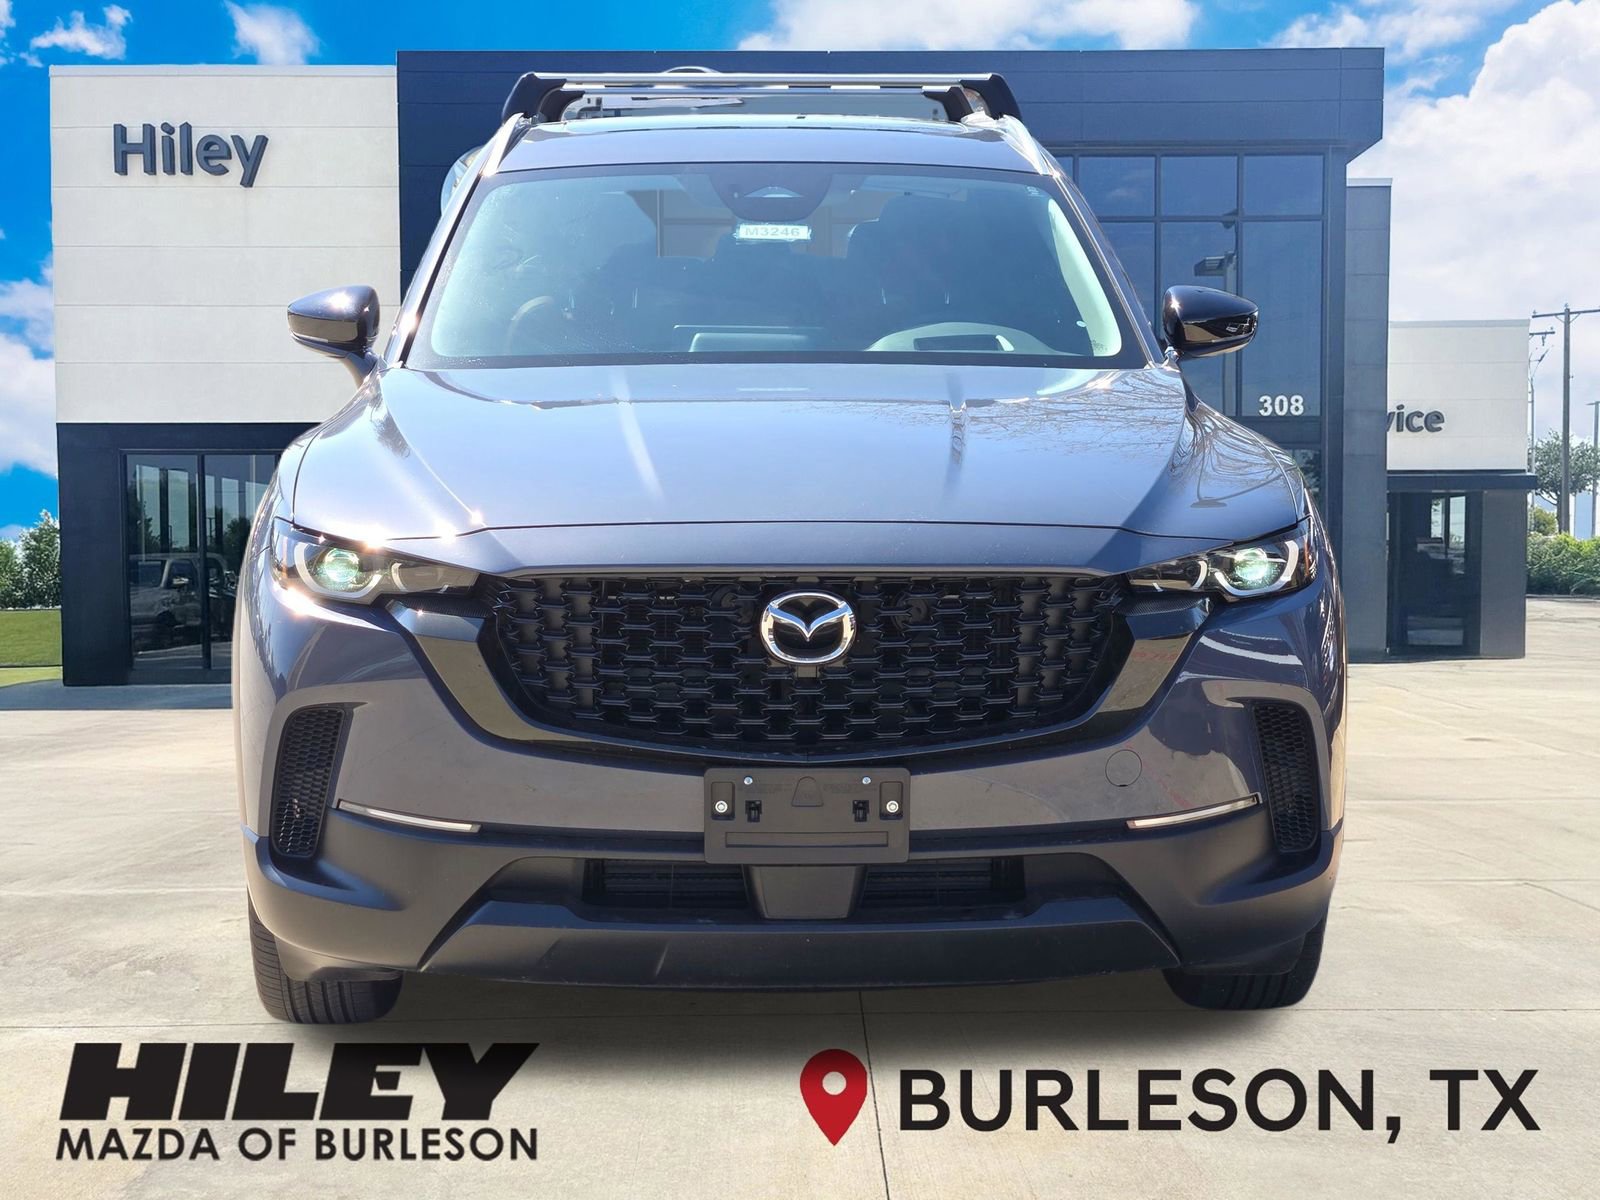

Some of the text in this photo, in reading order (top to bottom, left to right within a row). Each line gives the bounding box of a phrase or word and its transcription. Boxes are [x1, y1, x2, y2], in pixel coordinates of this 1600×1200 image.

[113, 122, 269, 188] Hiley
[744, 226, 801, 237] M3246
[1258, 394, 1304, 417] 308
